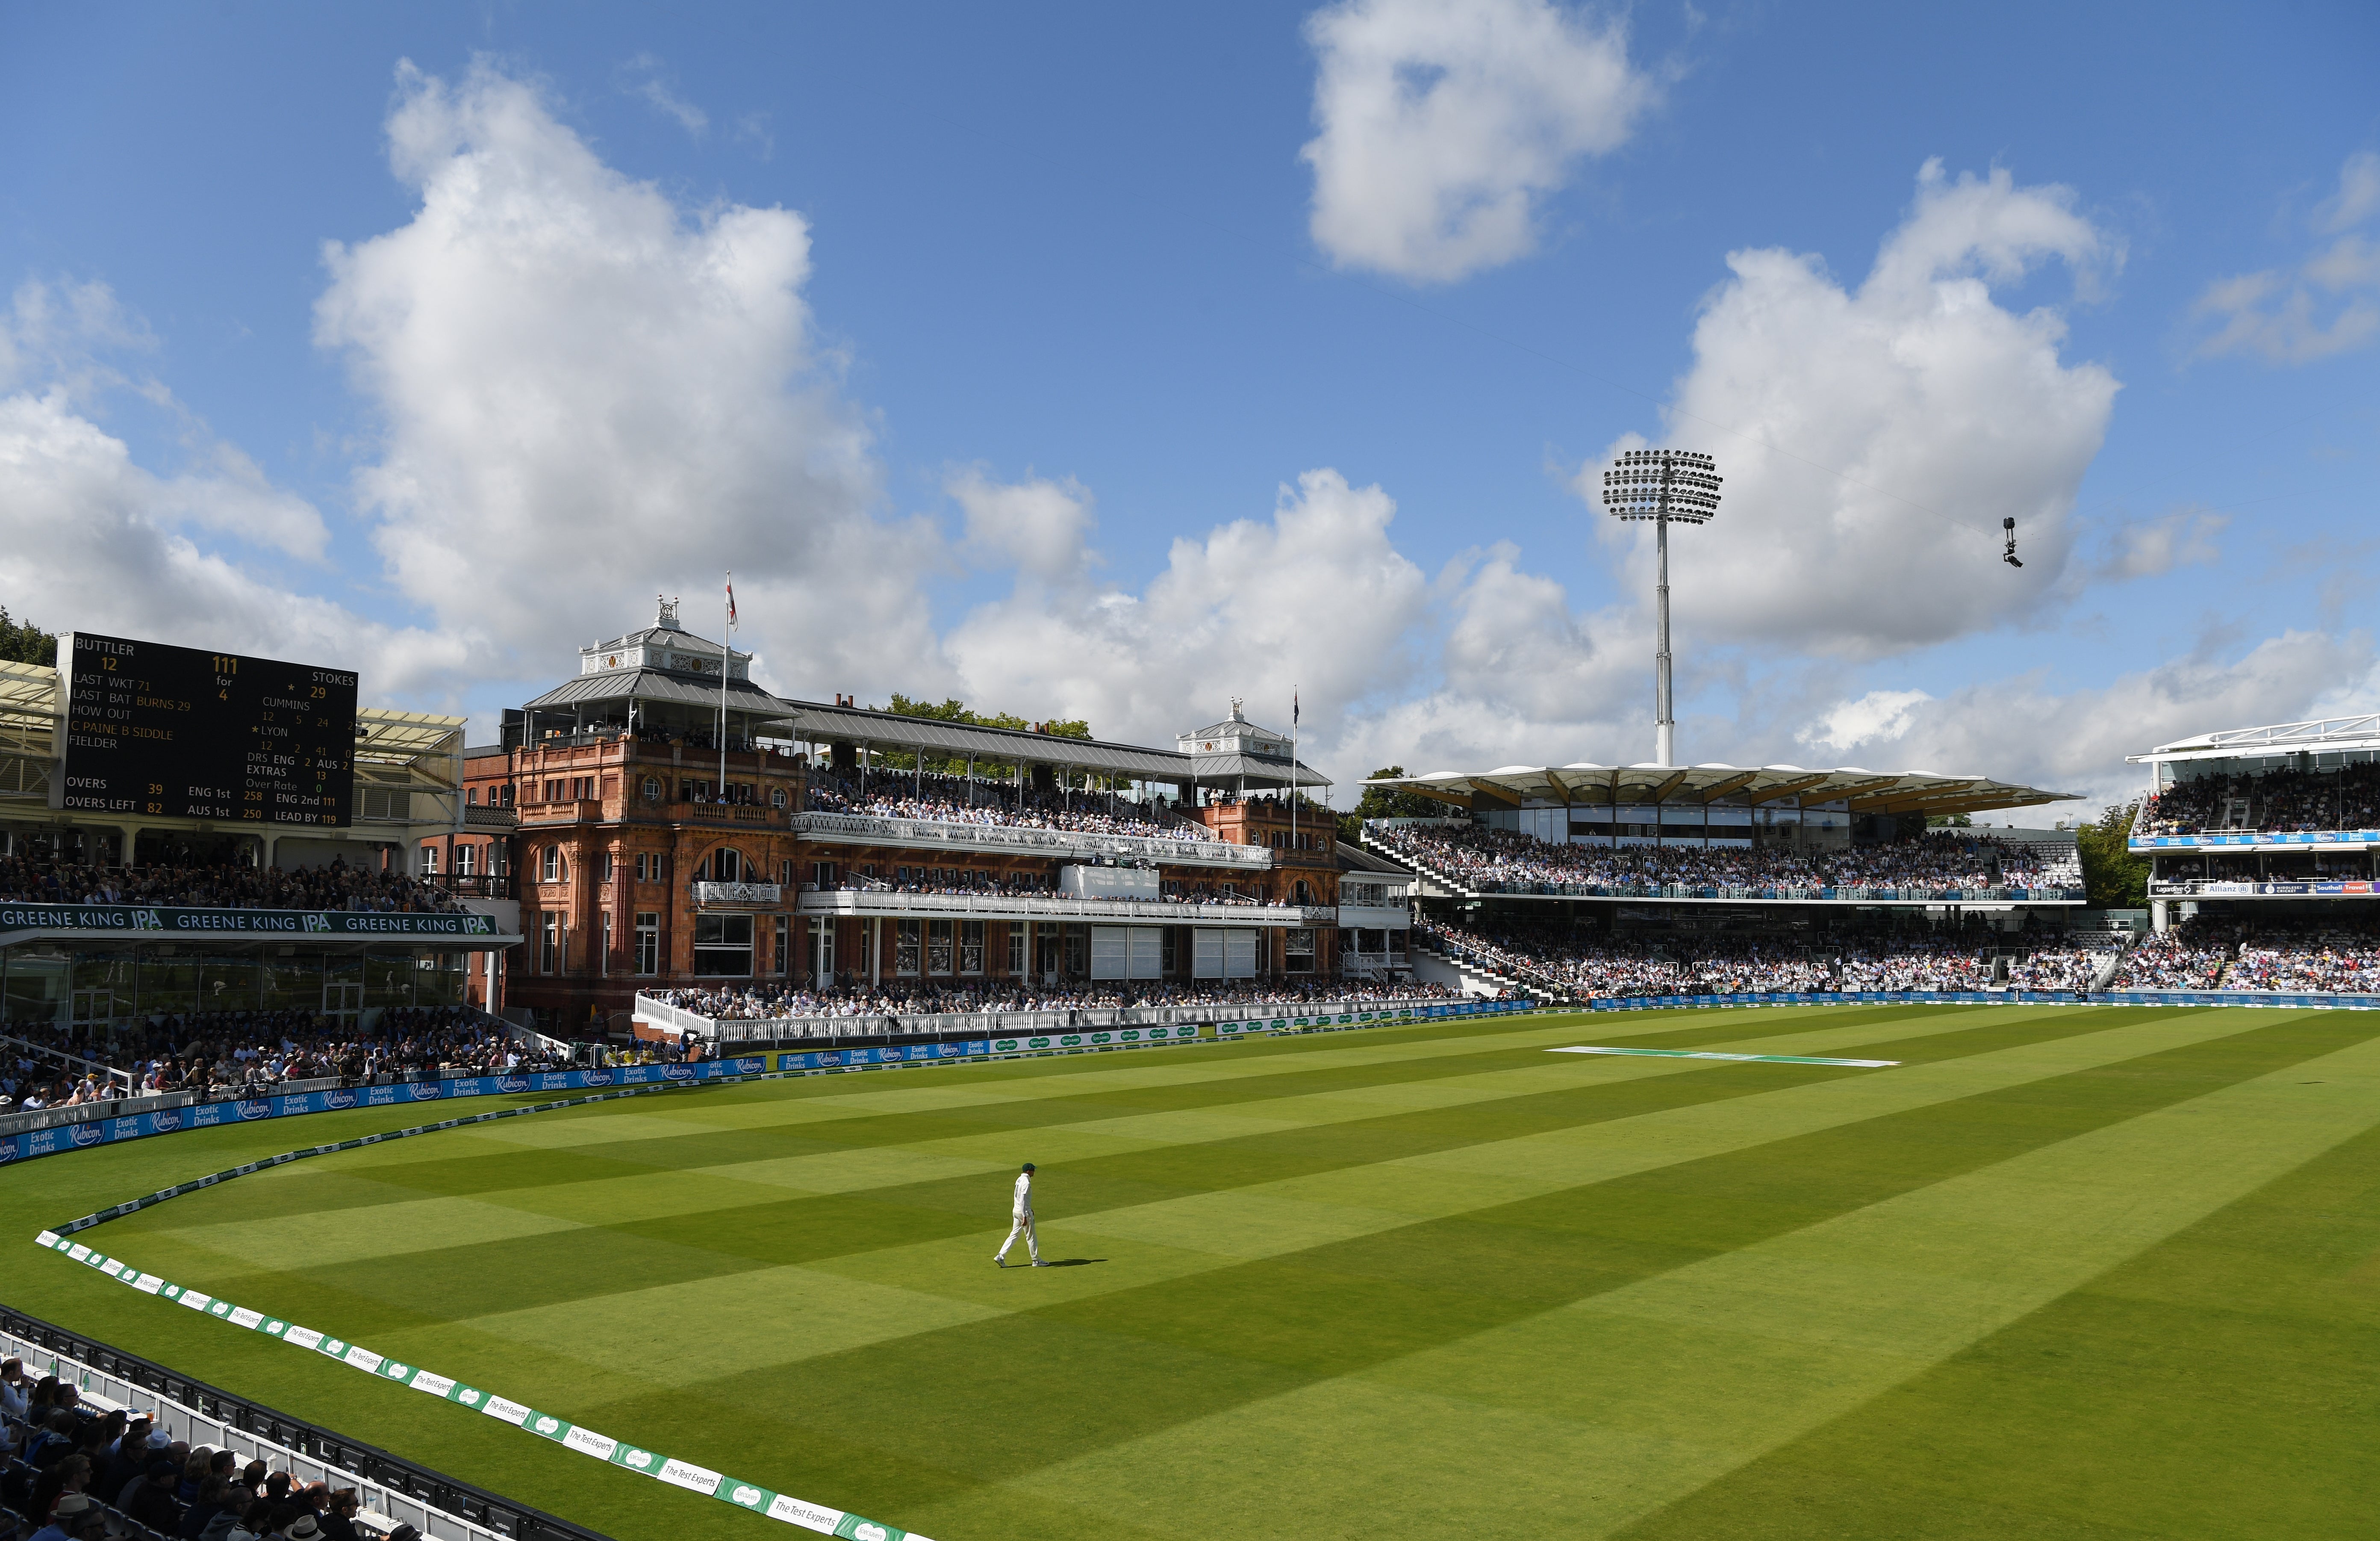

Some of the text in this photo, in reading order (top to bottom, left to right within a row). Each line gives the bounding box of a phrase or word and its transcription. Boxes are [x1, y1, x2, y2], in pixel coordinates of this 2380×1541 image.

[75, 638, 134, 656] BUTTLER
[102, 657, 117, 670] 12
[213, 656, 237, 674] 111
[74, 673, 150, 691] LAST WKT 71
[216, 675, 232, 687] for
[312, 671, 354, 686] STOKES
[219, 689, 227, 701] 4
[310, 687, 326, 699] 29
[73, 689, 191, 711] LAST BAT BURNS 29
[262, 697, 310, 711] CUMMINS
[72, 705, 132, 720] HOW OUT
[262, 712, 353, 730] 12 5 24 2
[71, 721, 173, 740] C PAINE B SIDDLE
[261, 726, 288, 737] LYON
[69, 735, 117, 749] FIELDER
[261, 741, 351, 758] 12 2 41 0
[247, 753, 348, 770] DRS ENG 2 AUS 2
[247, 765, 326, 780] EXTRAS 13
[67, 777, 162, 794] OVERS 39
[246, 778, 321, 792] Over Rate 0
[189, 786, 262, 801] ENG 1st 258
[276, 793, 336, 806] ENG 2nd 111
[65, 796, 162, 813] OVERS LEFT 82
[187, 805, 262, 818] AUS 1st 250
[275, 811, 336, 824] LEAD BY 119
[2, 909, 162, 930] GREENE KING IPA
[177, 913, 332, 932] GREENE KING IPA
[346, 917, 489, 934] GREENE KING IPA
[879, 1048, 901, 1060] Rubicon
[938, 1043, 958, 1055] Rubicon
[737, 1059, 762, 1071] Rubicon
[816, 1053, 840, 1065] Rubicon
[543, 1073, 566, 1081] Exotic
[662, 1065, 693, 1077] Rubicon
[455, 1079, 479, 1088] Exotic
[581, 1072, 611, 1084] Rubicon
[370, 1086, 393, 1096] Exotic
[409, 1083, 440, 1099] Rubicon
[453, 1087, 480, 1096] Drinks
[495, 1078, 527, 1092] Rubicon
[542, 1081, 567, 1089] Drinks
[285, 1095, 307, 1104] Exotic
[324, 1091, 355, 1107] Rubicon
[369, 1095, 394, 1105] Drinks
[195, 1105, 218, 1116] Exotic
[236, 1102, 270, 1119] Rubicon
[283, 1104, 309, 1114] Drinks
[116, 1117, 138, 1128] Exotic
[151, 1111, 180, 1128] Rubicon
[194, 1116, 219, 1126] Drinks
[31, 1131, 54, 1143] Exotic
[70, 1124, 102, 1143] Rubicon
[115, 1127, 138, 1139] Drinks
[29, 1143, 55, 1155] Drinks
[306, 1333, 320, 1343] Experts
[364, 1356, 379, 1366] Experts
[416, 1376, 453, 1391] The Test Experts
[489, 1401, 527, 1419] The Test Experts
[570, 1430, 612, 1451] The Test Experts
[629, 1453, 648, 1463] Specsavers
[665, 1466, 716, 1486] The Test Experts
[736, 1490, 757, 1501] Specsavers
[775, 1501, 836, 1526] The Test Experts
[858, 1527, 883, 1540] Specsavers
